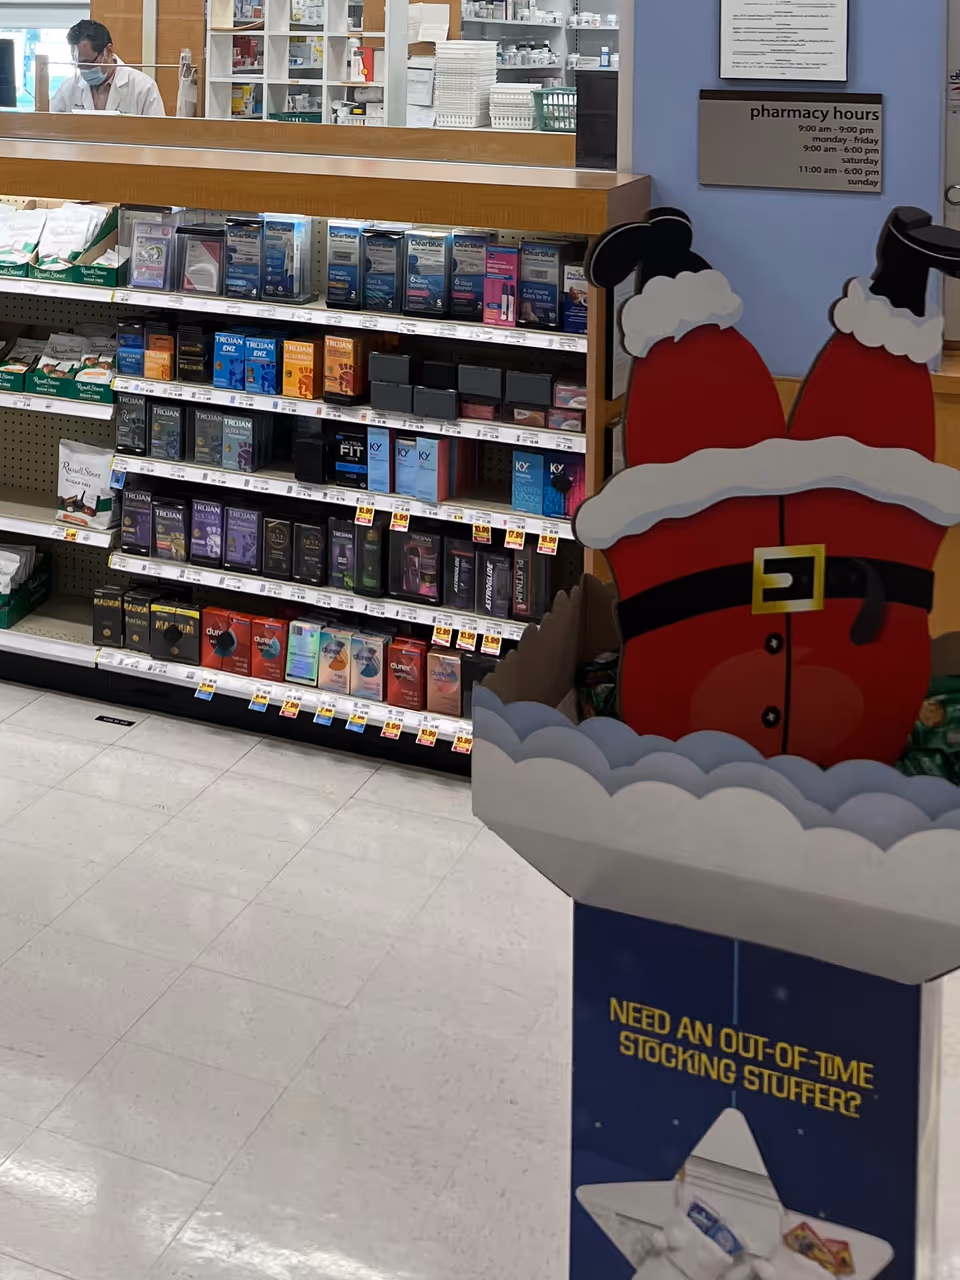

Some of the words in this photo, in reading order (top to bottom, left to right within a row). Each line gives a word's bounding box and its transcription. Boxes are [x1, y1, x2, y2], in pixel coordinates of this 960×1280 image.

[750, 105, 830, 122] pharmacy
[833, 106, 879, 120] hours
[839, 126, 857, 134] 9:00
[859, 127, 874, 135] pm
[812, 136, 848, 145] monday
[854, 136, 880, 146] friday
[803, 145, 821, 153] 9:00
[844, 146, 862, 154] 6:00
[865, 147, 879, 155] pm
[841, 157, 880, 167] saturday
[799, 166, 822, 174] 11:00
[865, 169, 880, 177] pm
[847, 178, 880, 187] sunday
[410, 239, 443, 248] Clearblue
[523, 249, 556, 258] Clearblue
[215, 336, 243, 345] TROJAN
[245, 341, 274, 350] TROJAN
[326, 339, 352, 350] TROJAN
[285, 344, 313, 353] TROJAN
[119, 396, 145, 405] TROJAN
[153, 407, 180, 417] TROJAN
[196, 412, 223, 422] TROJAN
[224, 418, 252, 428] TROJAN
[340, 445, 364, 458] FIT
[124, 492, 151, 502] TROJAN
[193, 503, 221, 514] TROJAN
[155, 509, 182, 520] TROJAN
[228, 510, 257, 520] TROJAN
[484, 561, 494, 611] ASTROGLIDE
[515, 559, 524, 603] PLATINUM
[155, 620, 194, 635] MAUM
[390, 662, 411, 672] durex
[609, 997, 671, 1035] NEED
[676, 1016, 713, 1048] AN
[720, 1027, 875, 1090] OUT-OF-TIME
[619, 1030, 737, 1085] STOCKING
[743, 1064, 862, 1119] STUFFER?
